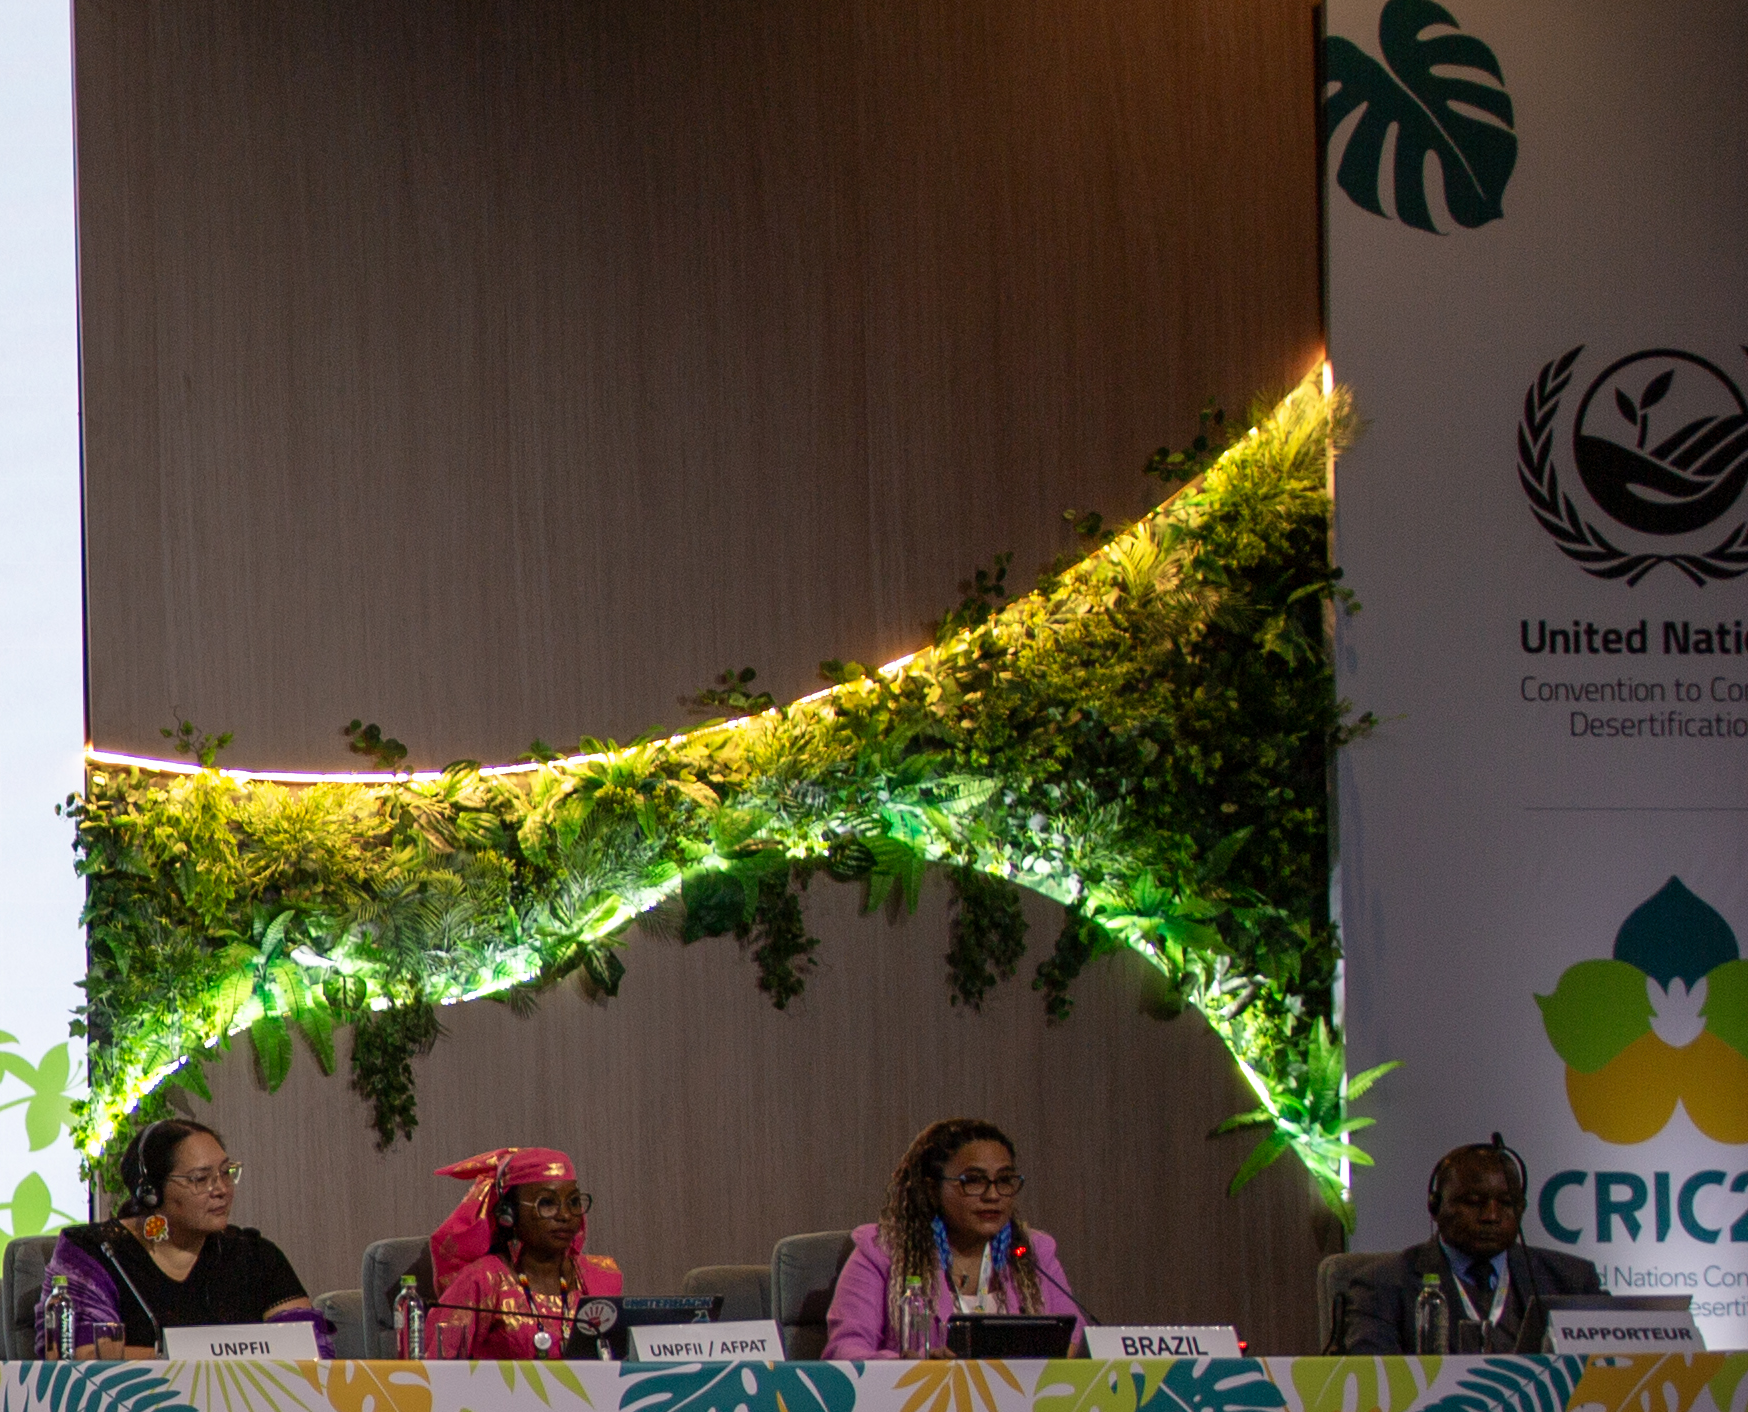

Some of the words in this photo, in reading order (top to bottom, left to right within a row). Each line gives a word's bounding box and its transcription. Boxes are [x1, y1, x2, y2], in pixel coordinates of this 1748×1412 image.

[1521, 620, 1648, 654] United
[1663, 620, 1748, 655] Nati
[1521, 676, 1665, 702] Convention
[1674, 679, 1702, 702] to
[1710, 676, 1748, 702] Co
[1614, 1265, 1697, 1288] Nations
[1561, 1327, 1692, 1340] RAPPORTEUR
[211, 1342, 270, 1356] UNPFII
[650, 1343, 703, 1357] UNPFII
[709, 1341, 714, 1357] /
[721, 1339, 766, 1353] AFPAT
[1121, 1336, 1208, 1356] BRAZIL
